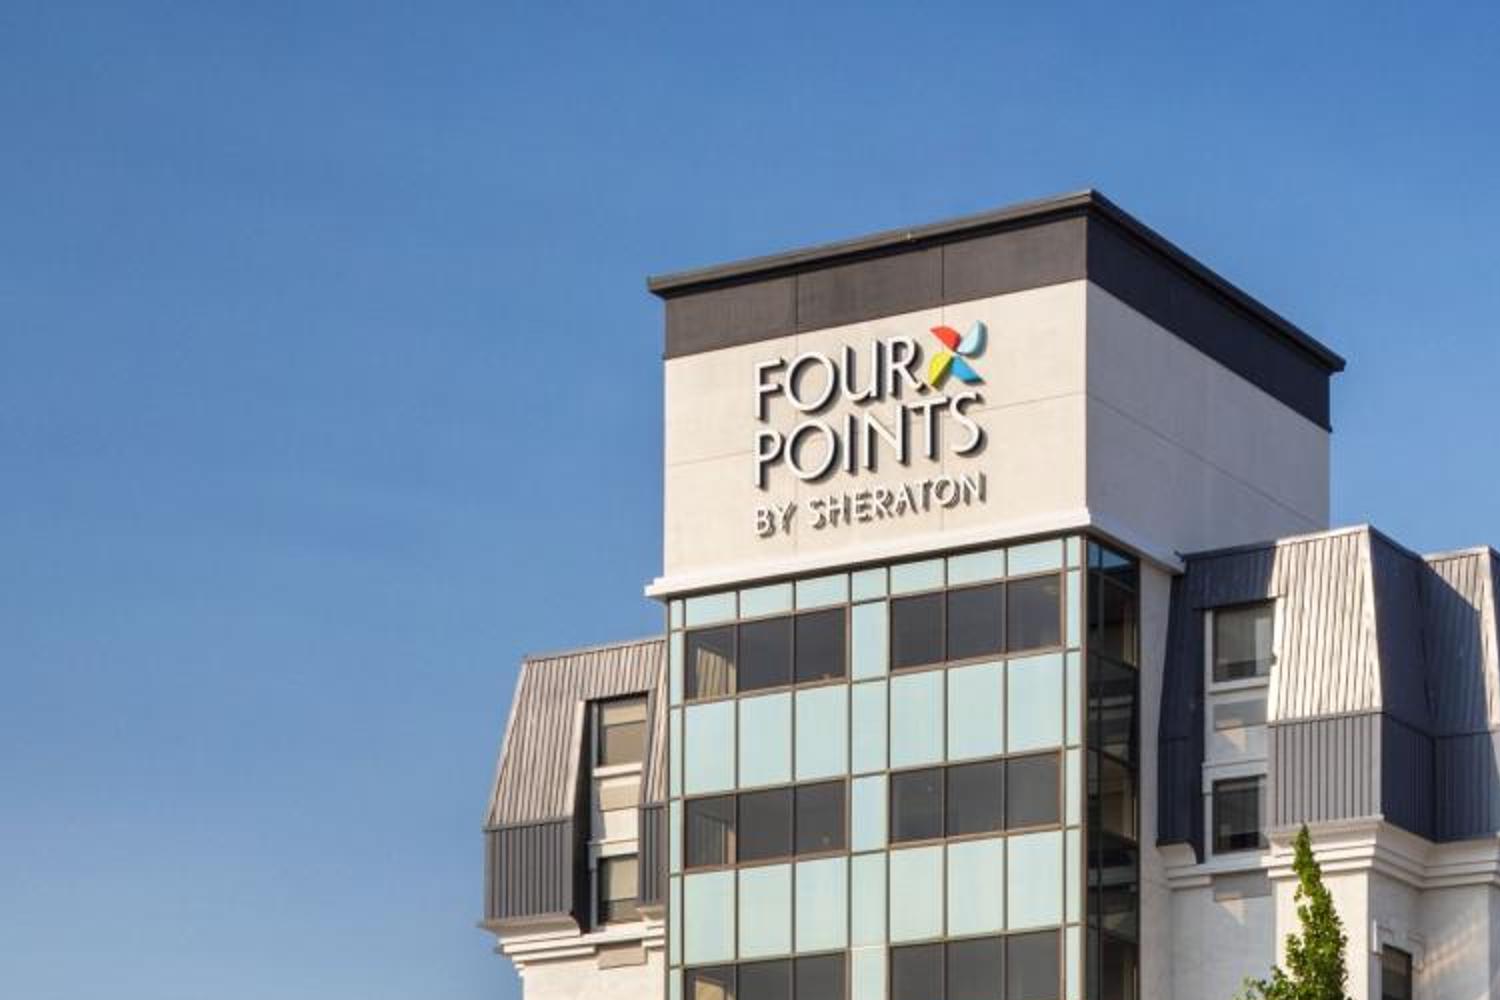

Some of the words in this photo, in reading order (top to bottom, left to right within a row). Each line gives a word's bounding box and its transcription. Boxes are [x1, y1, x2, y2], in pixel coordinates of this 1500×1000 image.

[755, 337, 923, 421] FOUR
[755, 391, 986, 490] POINTS
[754, 502, 797, 538] BY
[807, 472, 987, 528] SHERATON
